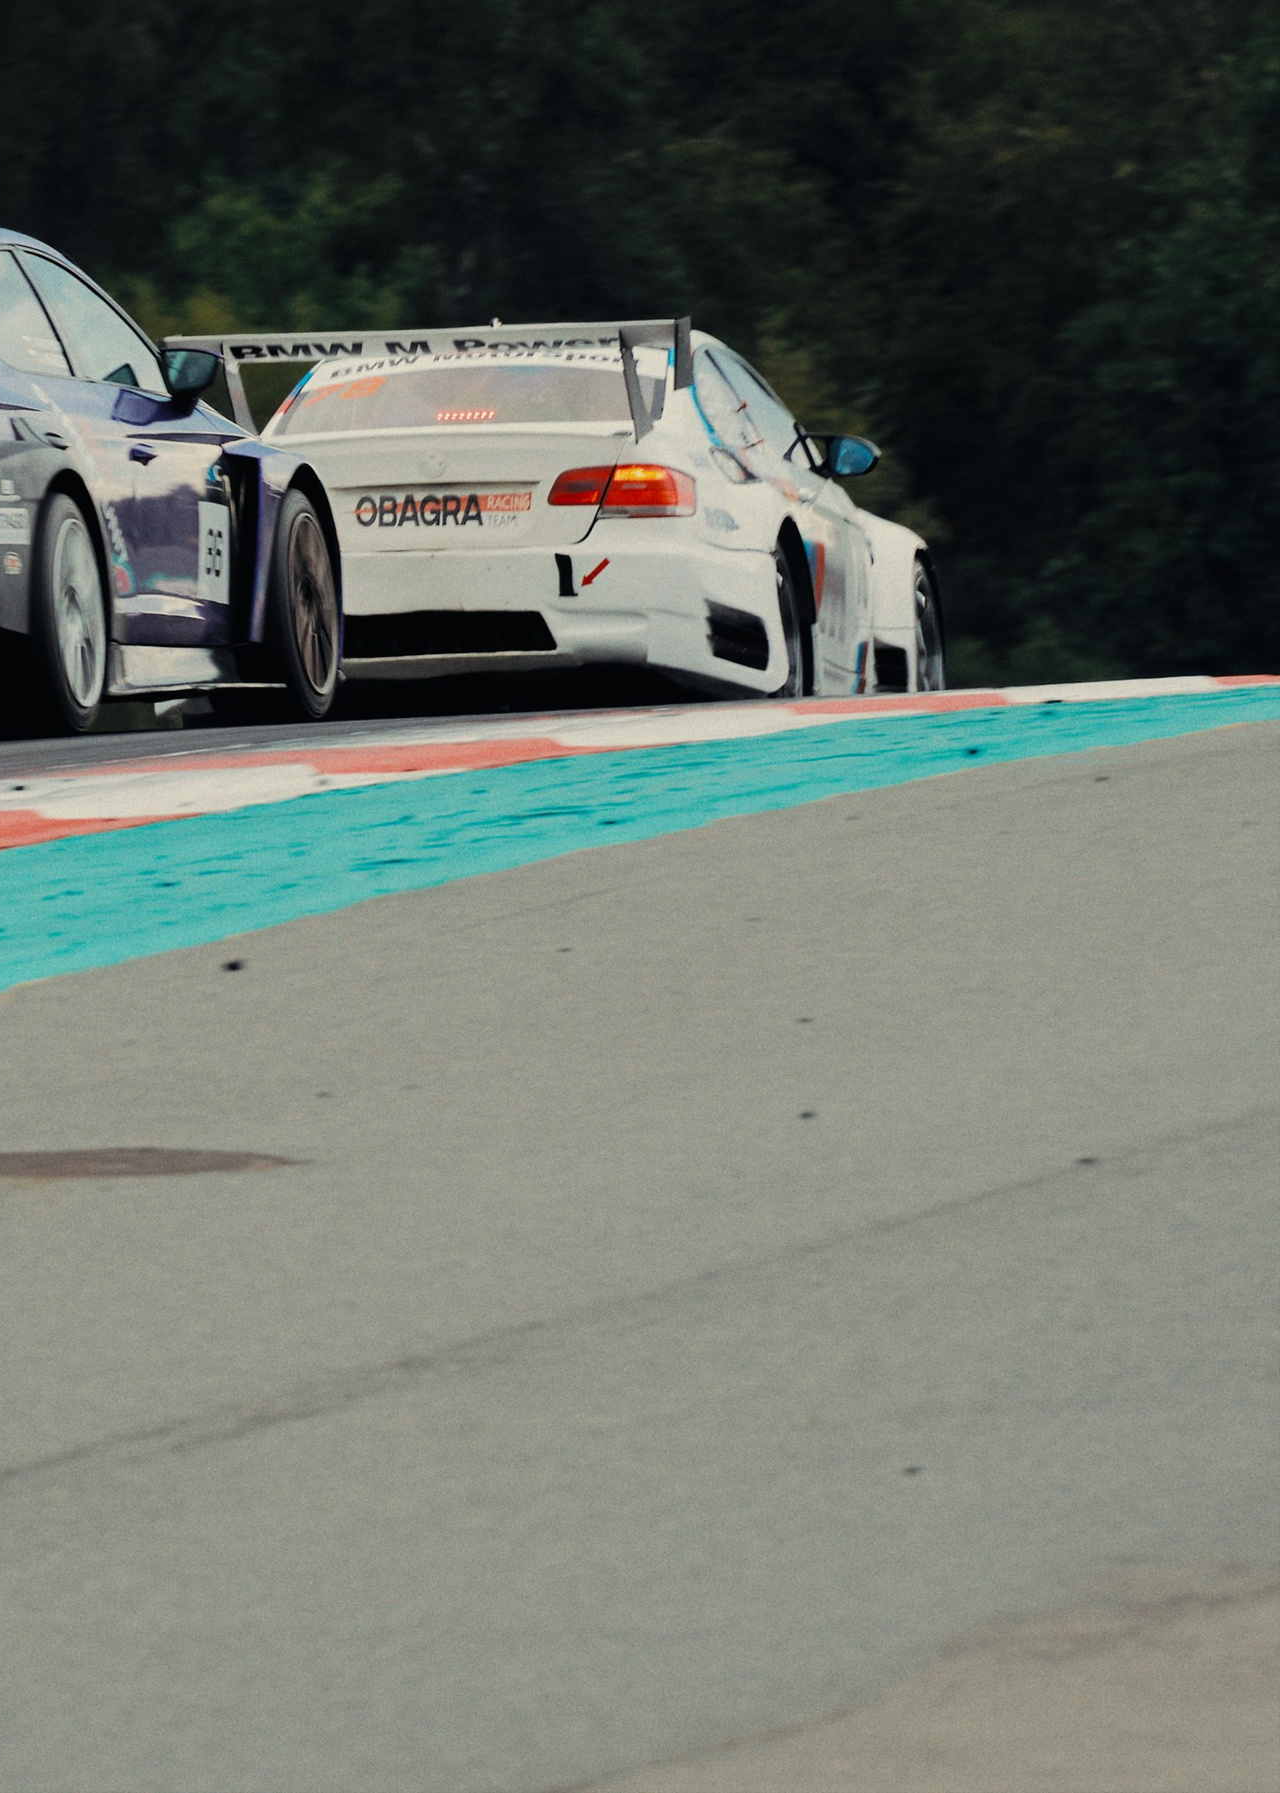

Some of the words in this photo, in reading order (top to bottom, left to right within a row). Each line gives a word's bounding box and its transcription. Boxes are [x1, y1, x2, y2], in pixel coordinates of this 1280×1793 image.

[230, 342, 363, 359] BMW
[385, 340, 431, 355] M
[453, 336, 619, 352] Power
[330, 357, 420, 378] BMW
[356, 494, 483, 527] OBAGRA
[487, 494, 531, 510] RACING
[487, 515, 518, 527] TEAM
